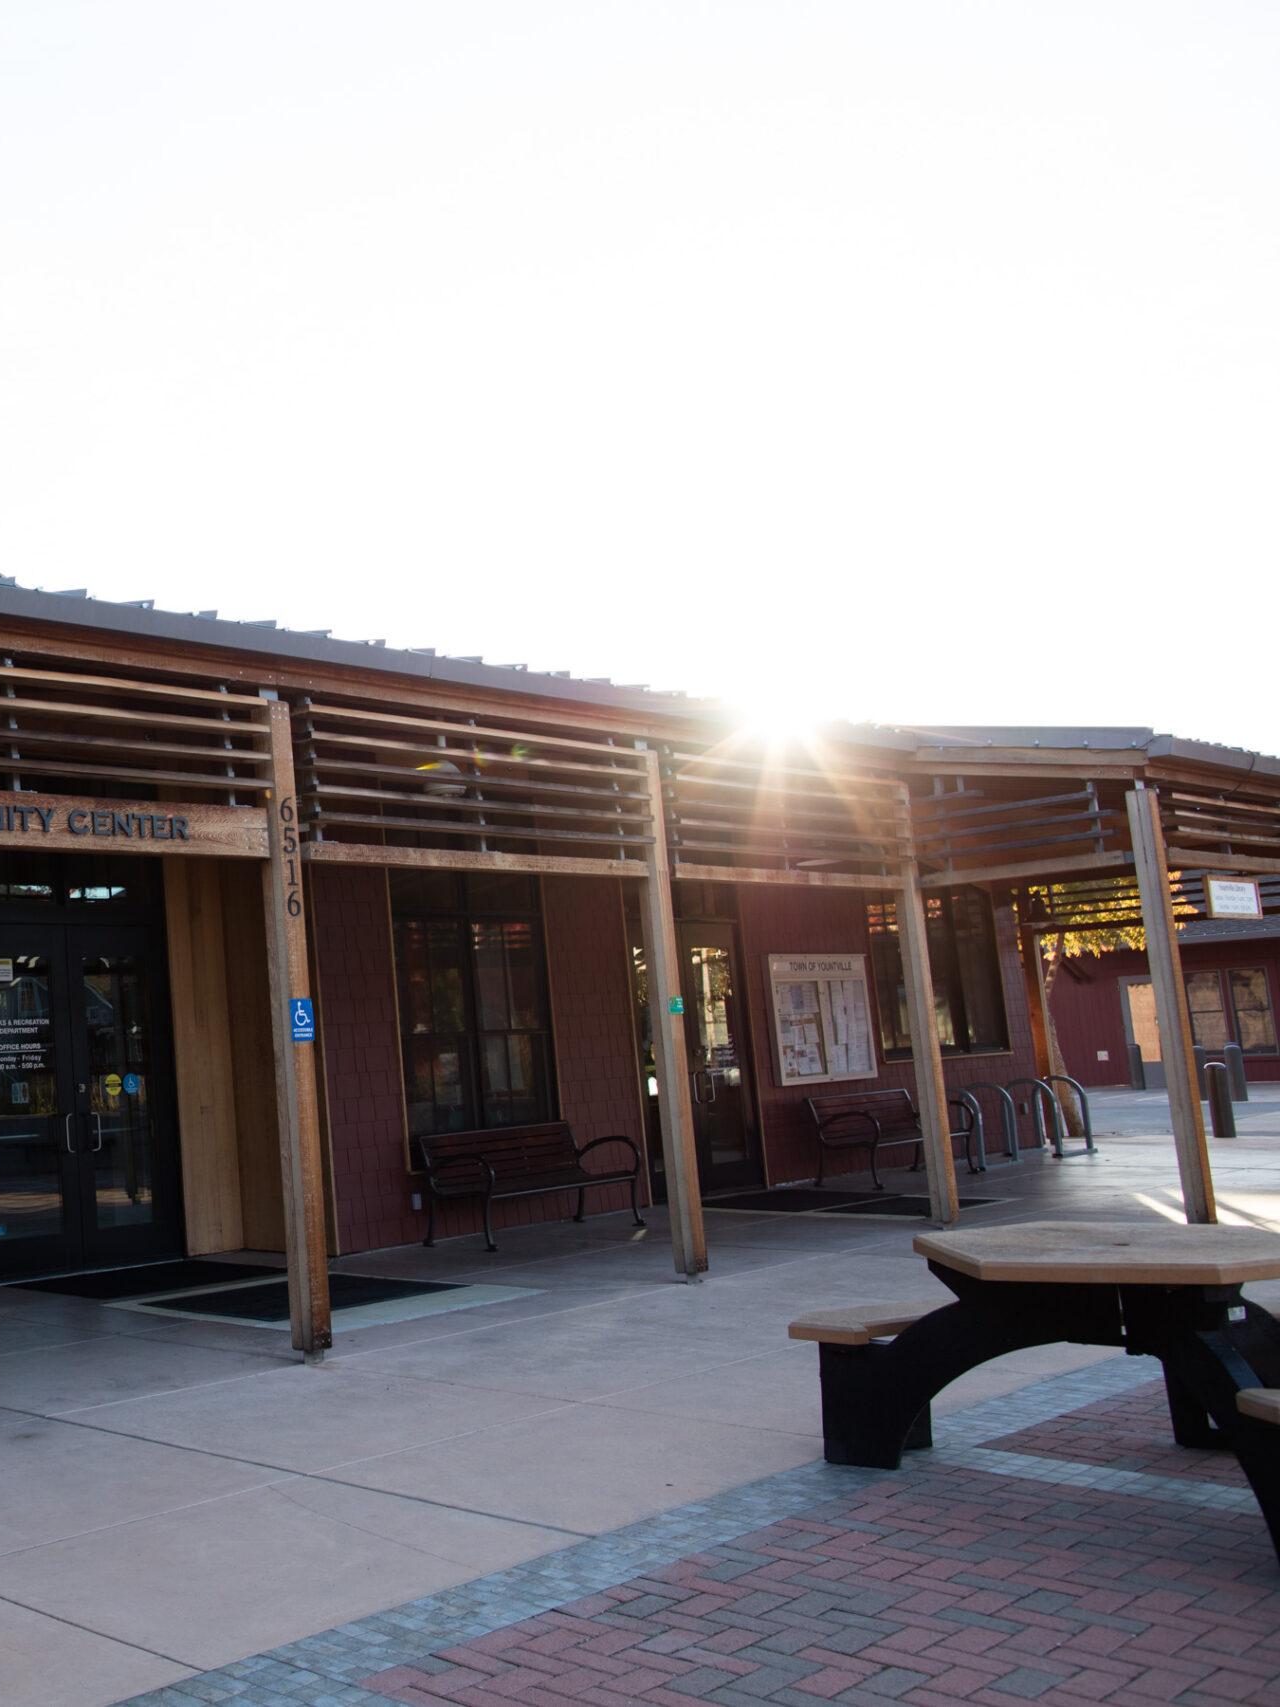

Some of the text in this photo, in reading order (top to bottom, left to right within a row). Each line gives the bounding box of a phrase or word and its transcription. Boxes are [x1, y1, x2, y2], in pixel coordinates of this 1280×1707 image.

[69, 810, 189, 840] CENTER
[280, 797, 301, 917] 6516
[789, 961, 852, 971] TOWN OF YOUNTVILLE
